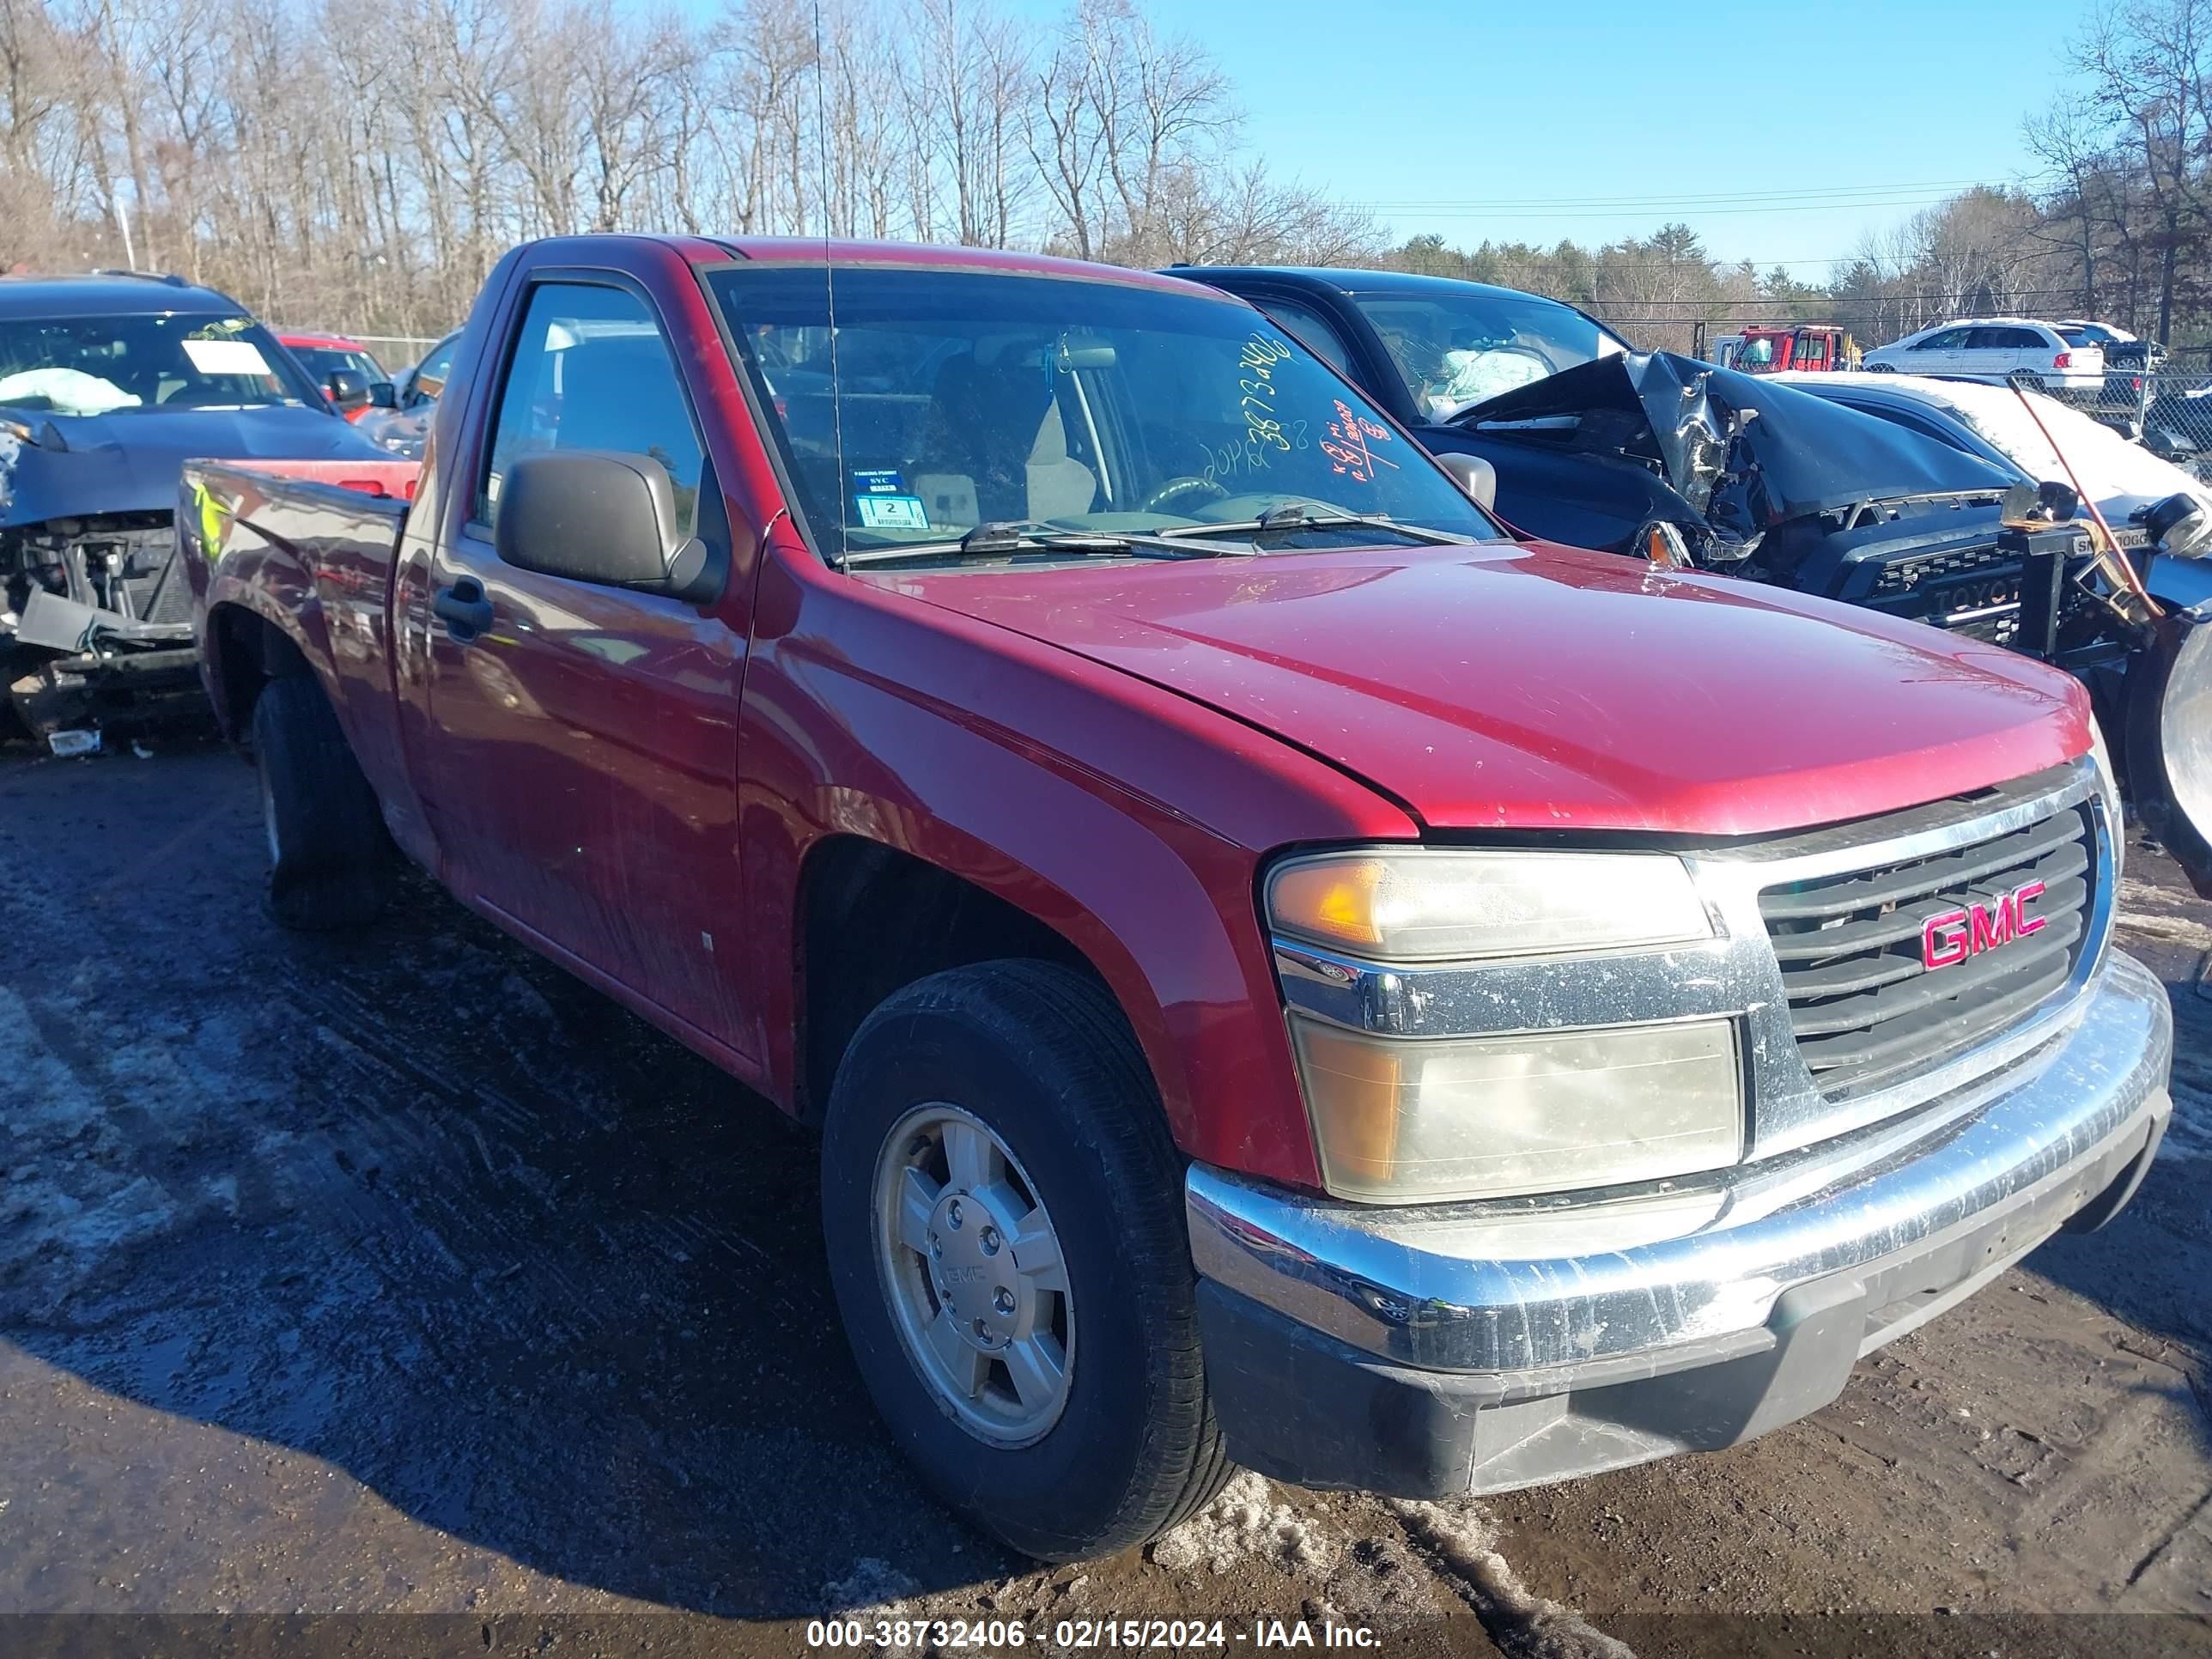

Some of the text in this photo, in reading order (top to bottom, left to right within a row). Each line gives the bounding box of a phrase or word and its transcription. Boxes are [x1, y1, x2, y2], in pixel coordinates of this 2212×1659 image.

[885, 502, 896, 514] 2
[1935, 578, 2023, 613] TOYOT
[1920, 878, 2048, 972] GMC
